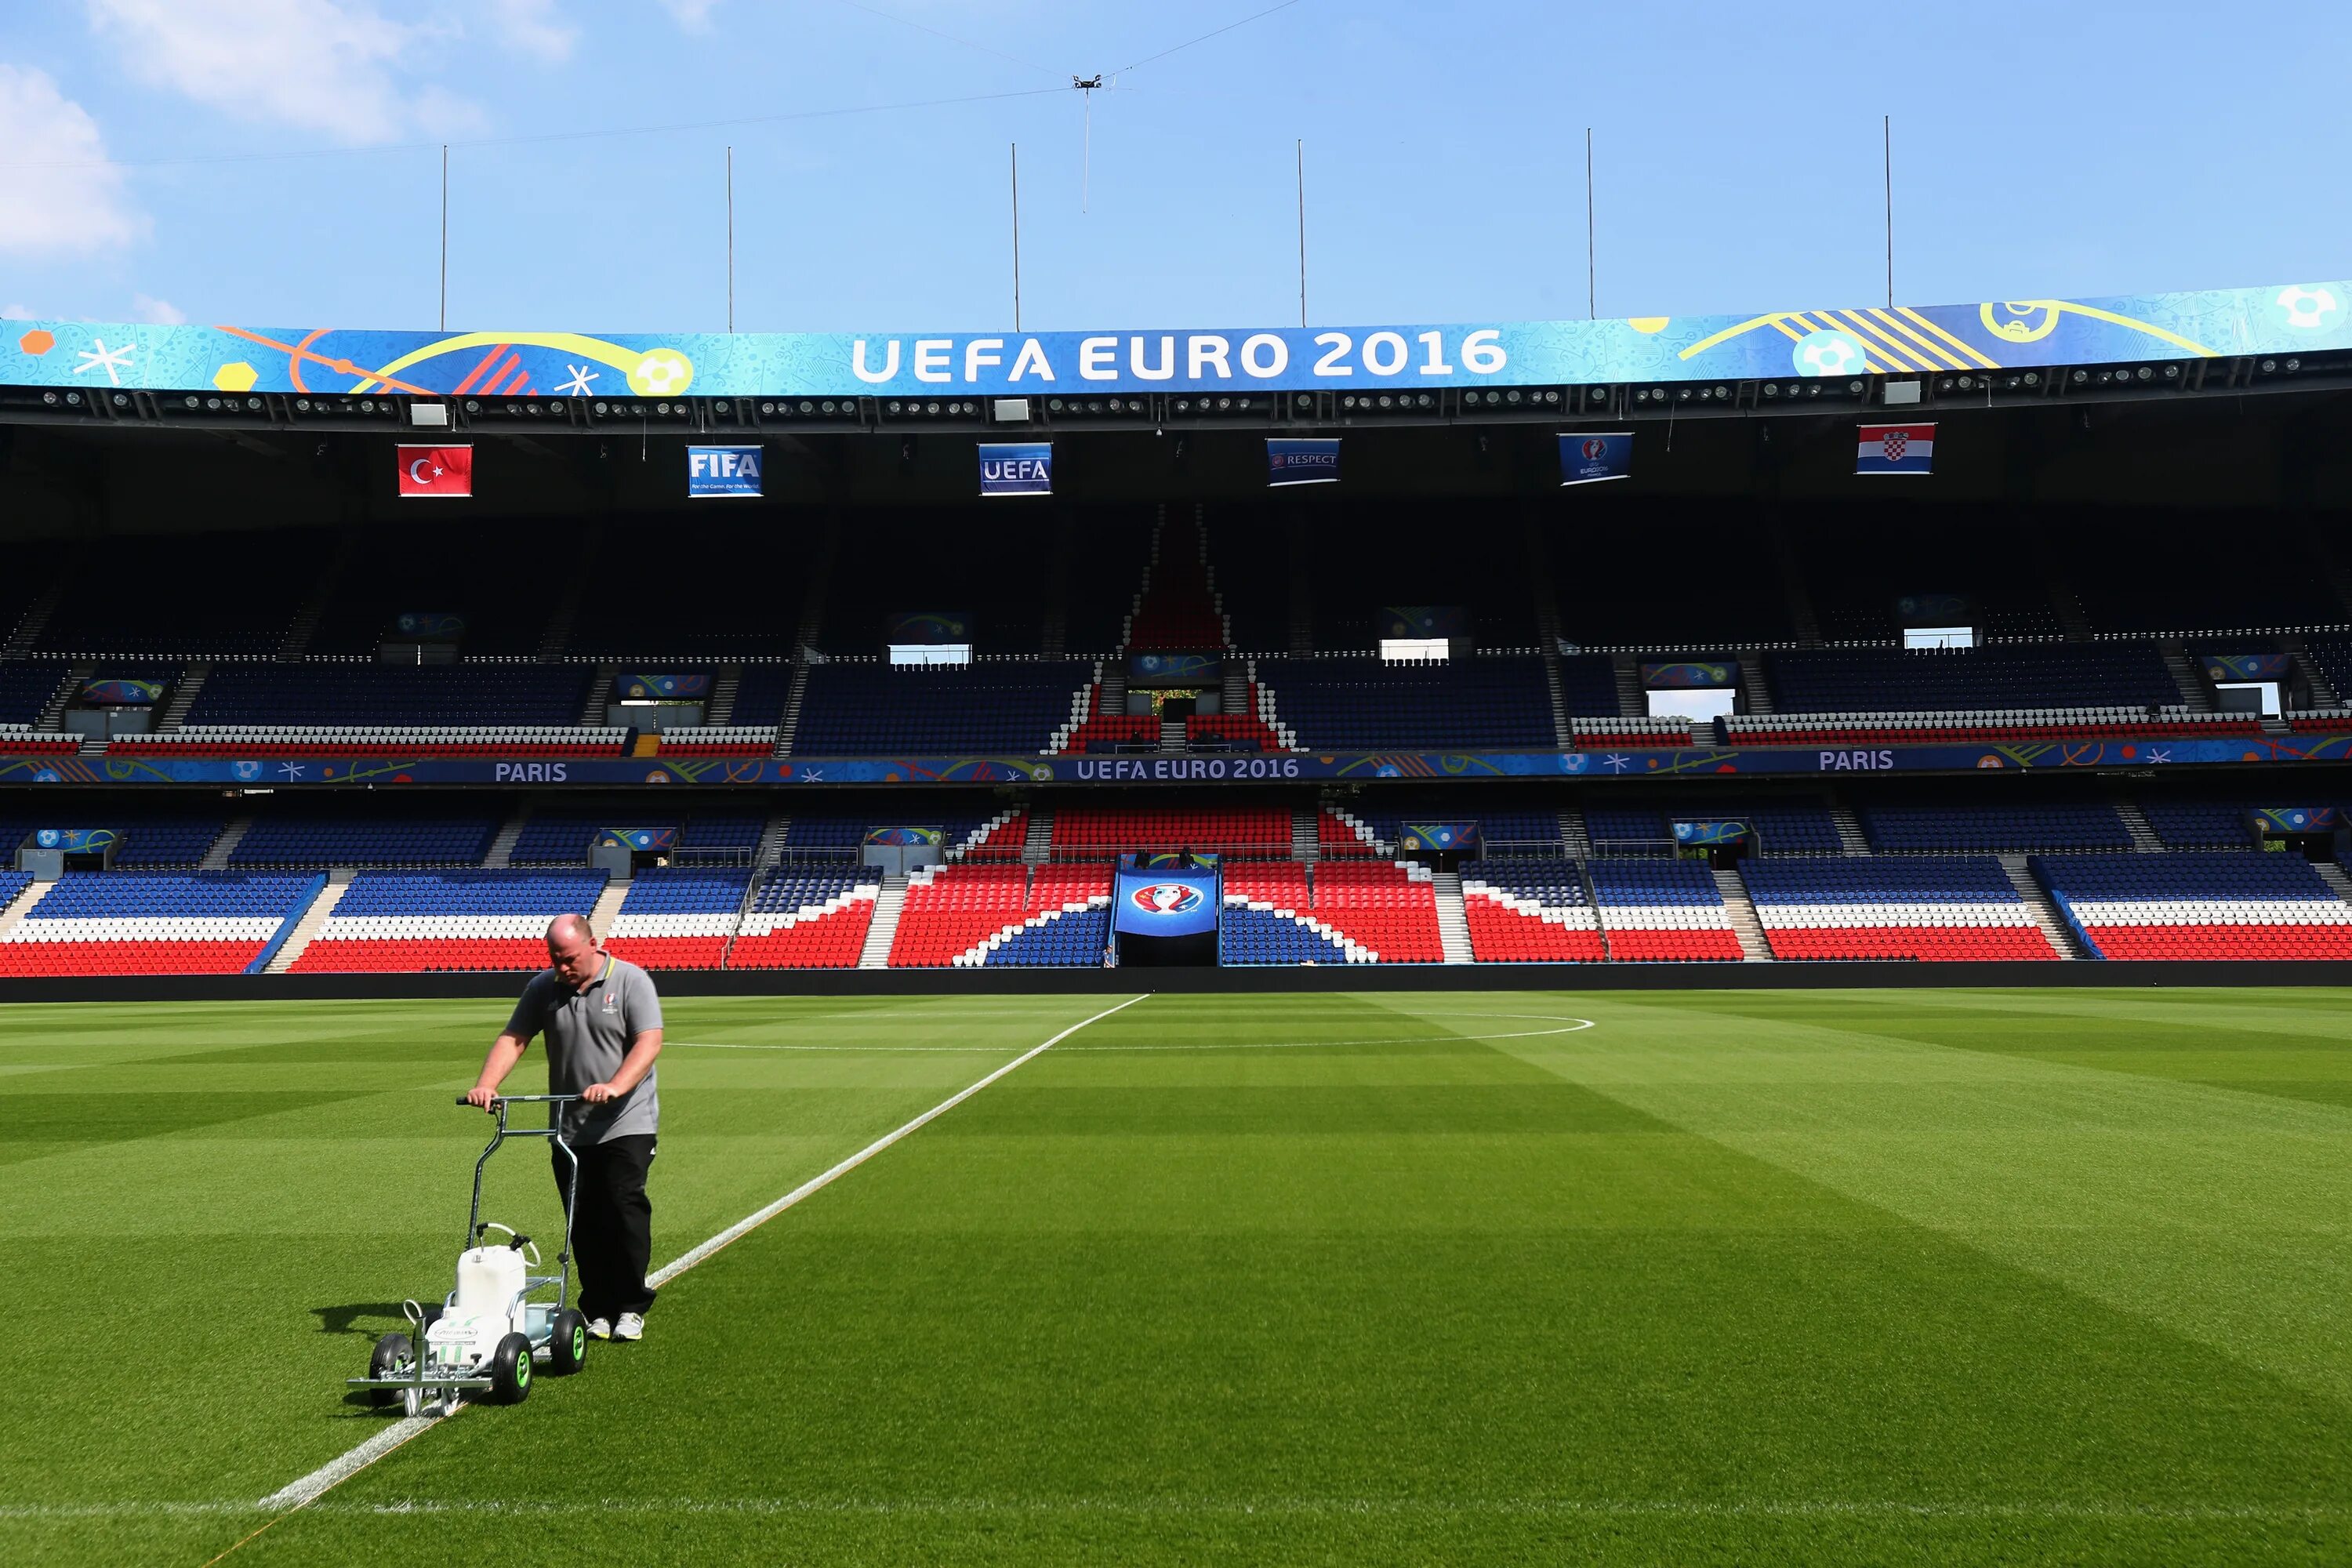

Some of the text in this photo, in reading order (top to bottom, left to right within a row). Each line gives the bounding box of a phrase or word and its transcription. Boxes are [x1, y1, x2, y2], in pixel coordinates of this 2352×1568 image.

[851, 329, 1508, 383] UEFA EURO 2016
[690, 454, 760, 477] FIFA
[984, 459, 1048, 480] UEFA
[1287, 455, 1337, 465] RESPECT
[1077, 758, 1299, 779] UEFA EURO 2016
[1820, 750, 1894, 770] PARIS
[495, 763, 568, 782] PARIS
